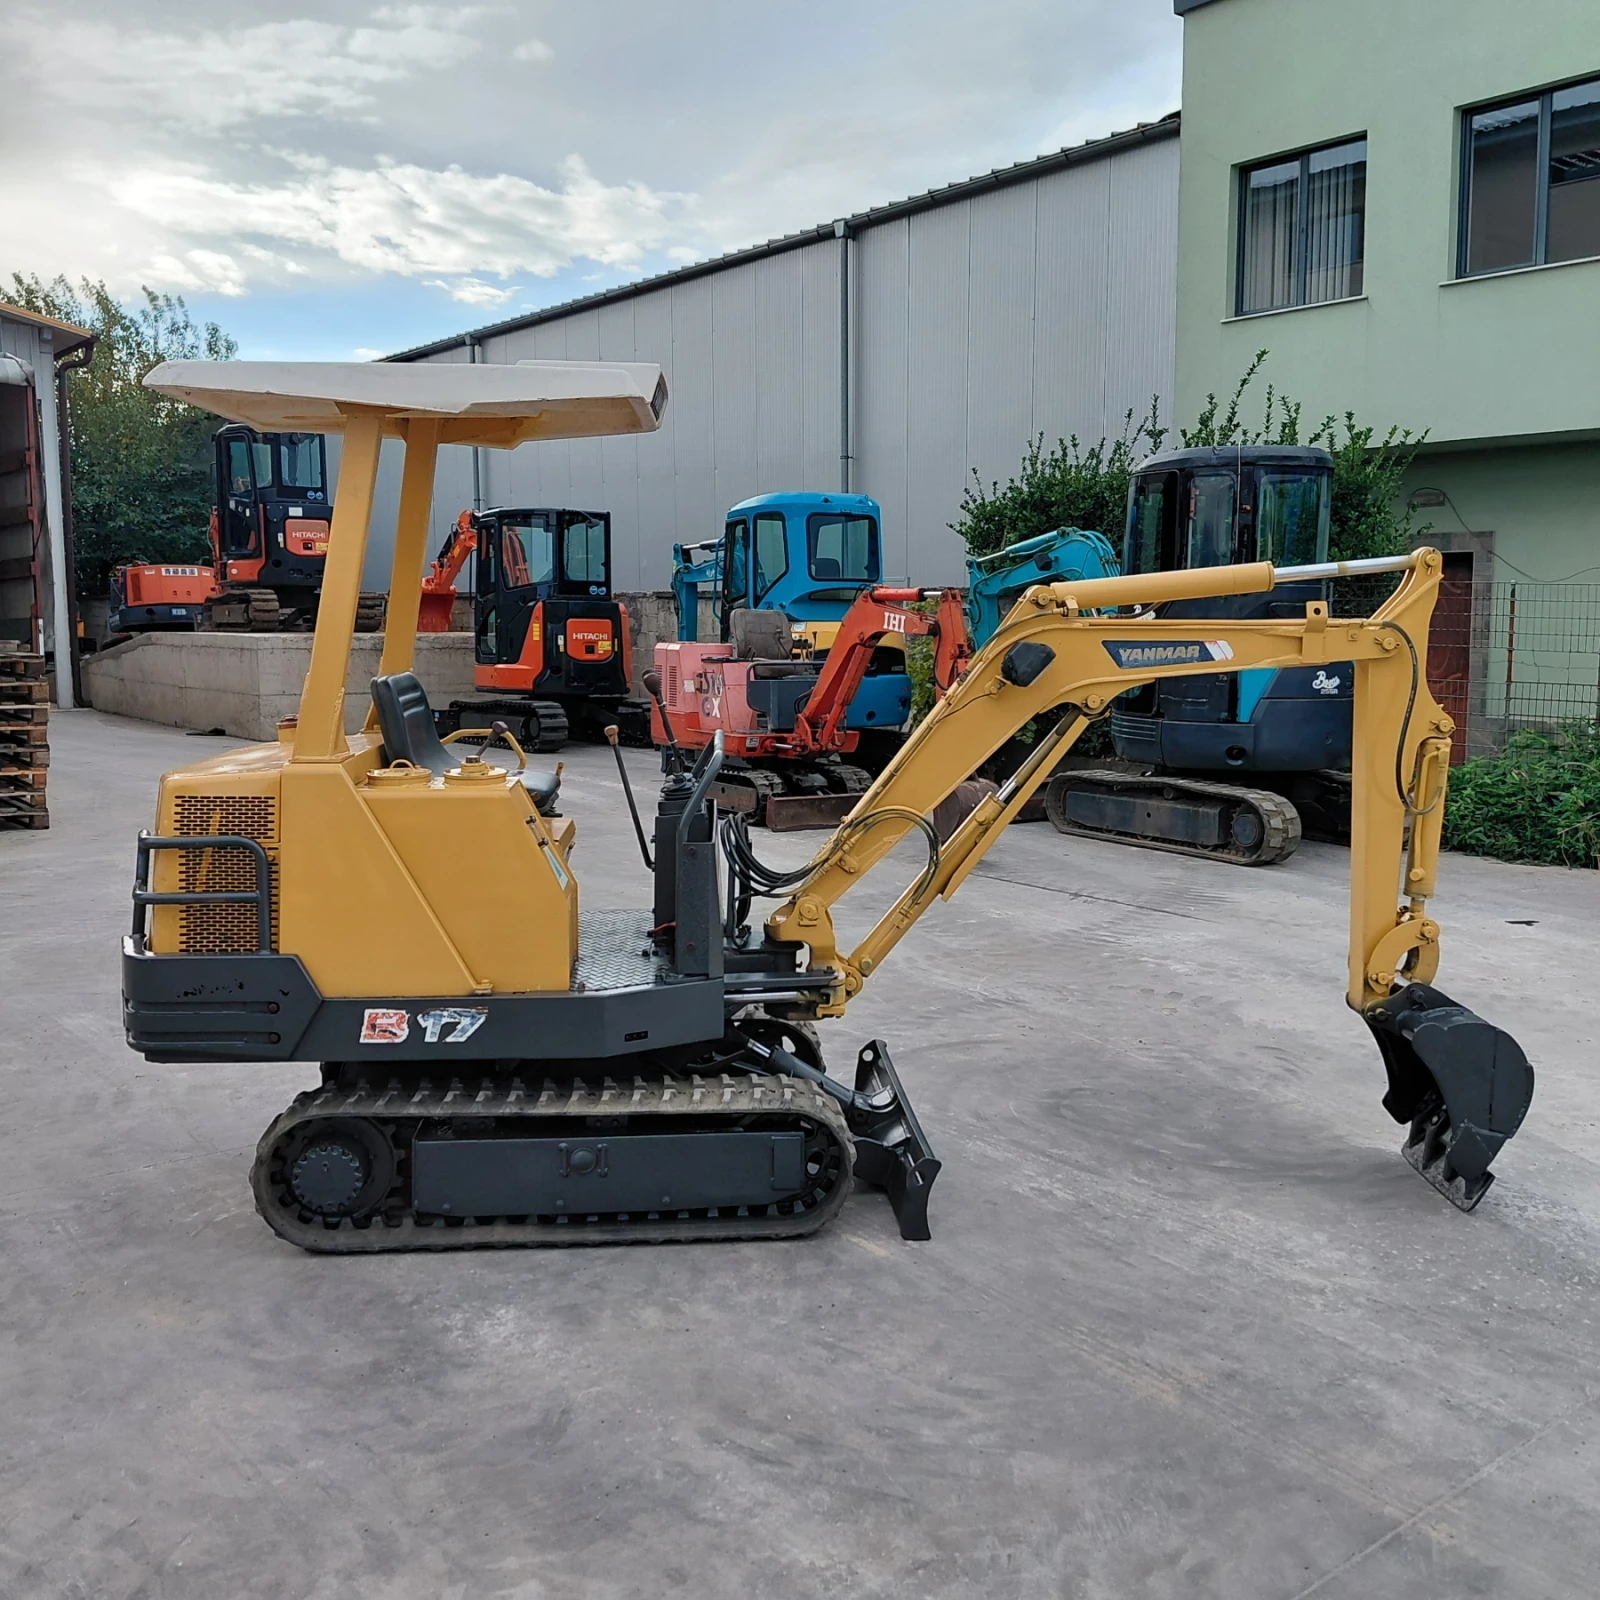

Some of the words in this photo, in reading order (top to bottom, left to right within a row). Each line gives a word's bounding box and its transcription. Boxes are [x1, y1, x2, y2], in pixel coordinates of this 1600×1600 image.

[292, 531, 325, 539] HITACHI
[883, 611, 906, 633] IHI
[573, 632, 608, 640] HITACHI
[1119, 645, 1200, 661] YANMAR
